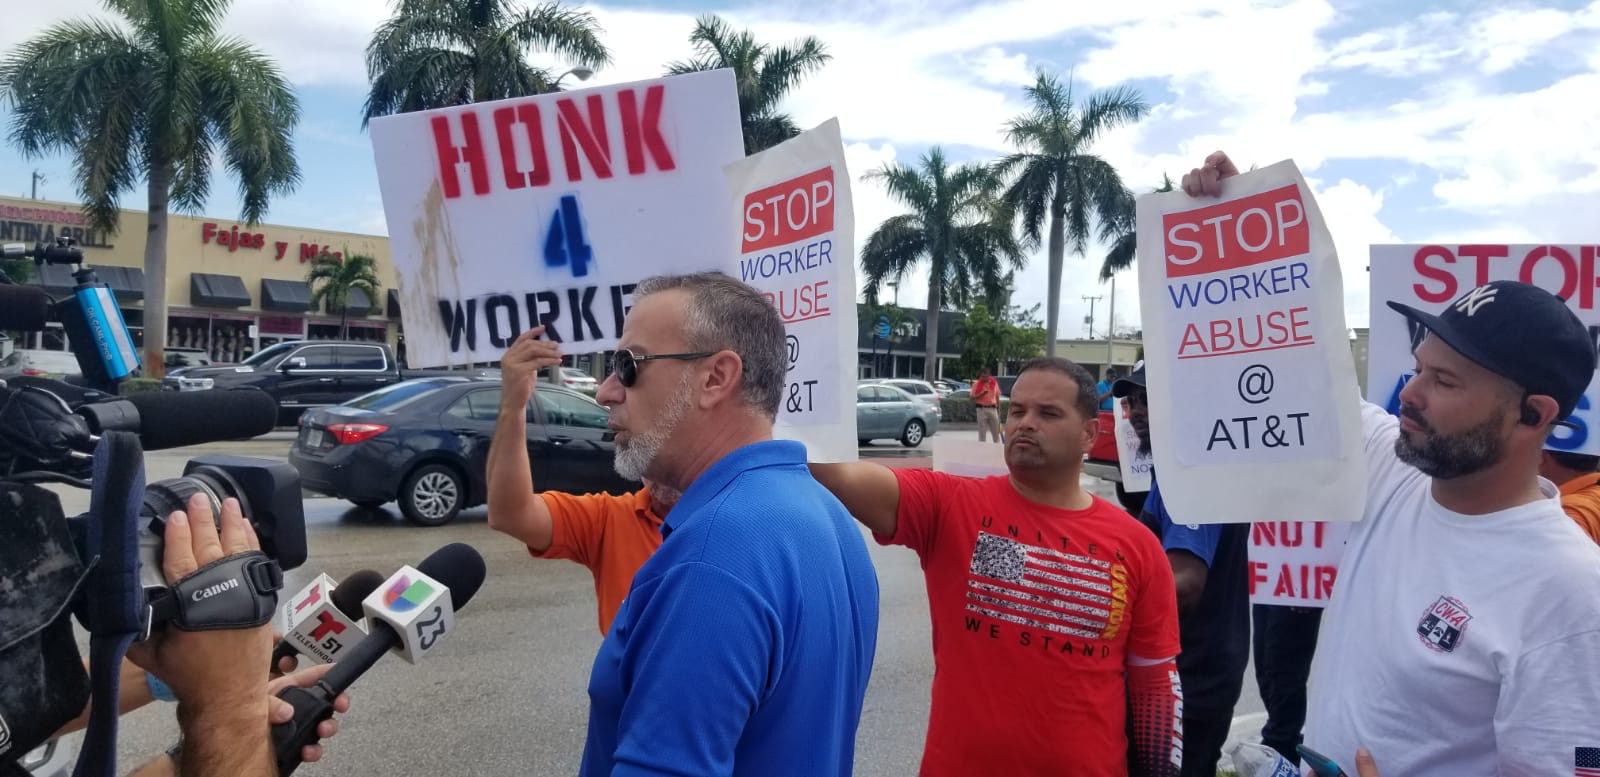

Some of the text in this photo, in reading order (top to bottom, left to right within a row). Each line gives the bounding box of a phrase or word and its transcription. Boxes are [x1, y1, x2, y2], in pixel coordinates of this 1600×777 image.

[431, 85, 676, 199] HONK
[744, 180, 834, 242] STOP
[202, 222, 265, 253] Fajas
[275, 241, 288, 261] y
[543, 195, 592, 277] 4
[1167, 198, 1305, 266] STOP
[741, 239, 833, 283] WORKER
[761, 281, 830, 320] USE
[1168, 261, 1311, 309] WORKER
[438, 283, 639, 352] WORKE
[1177, 306, 1314, 357] ABUSE
[1237, 364, 1275, 404] @
[1206, 412, 1310, 451] AT&T
[191, 578, 239, 602] Canon
[1248, 561, 1338, 600] FAIR
[416, 606, 445, 650] 23
[1435, 602, 1467, 627] CWA
[293, 631, 333, 663] TELEMUNDO
[322, 637, 344, 655] 51
[964, 617, 1111, 658] WE STAND
